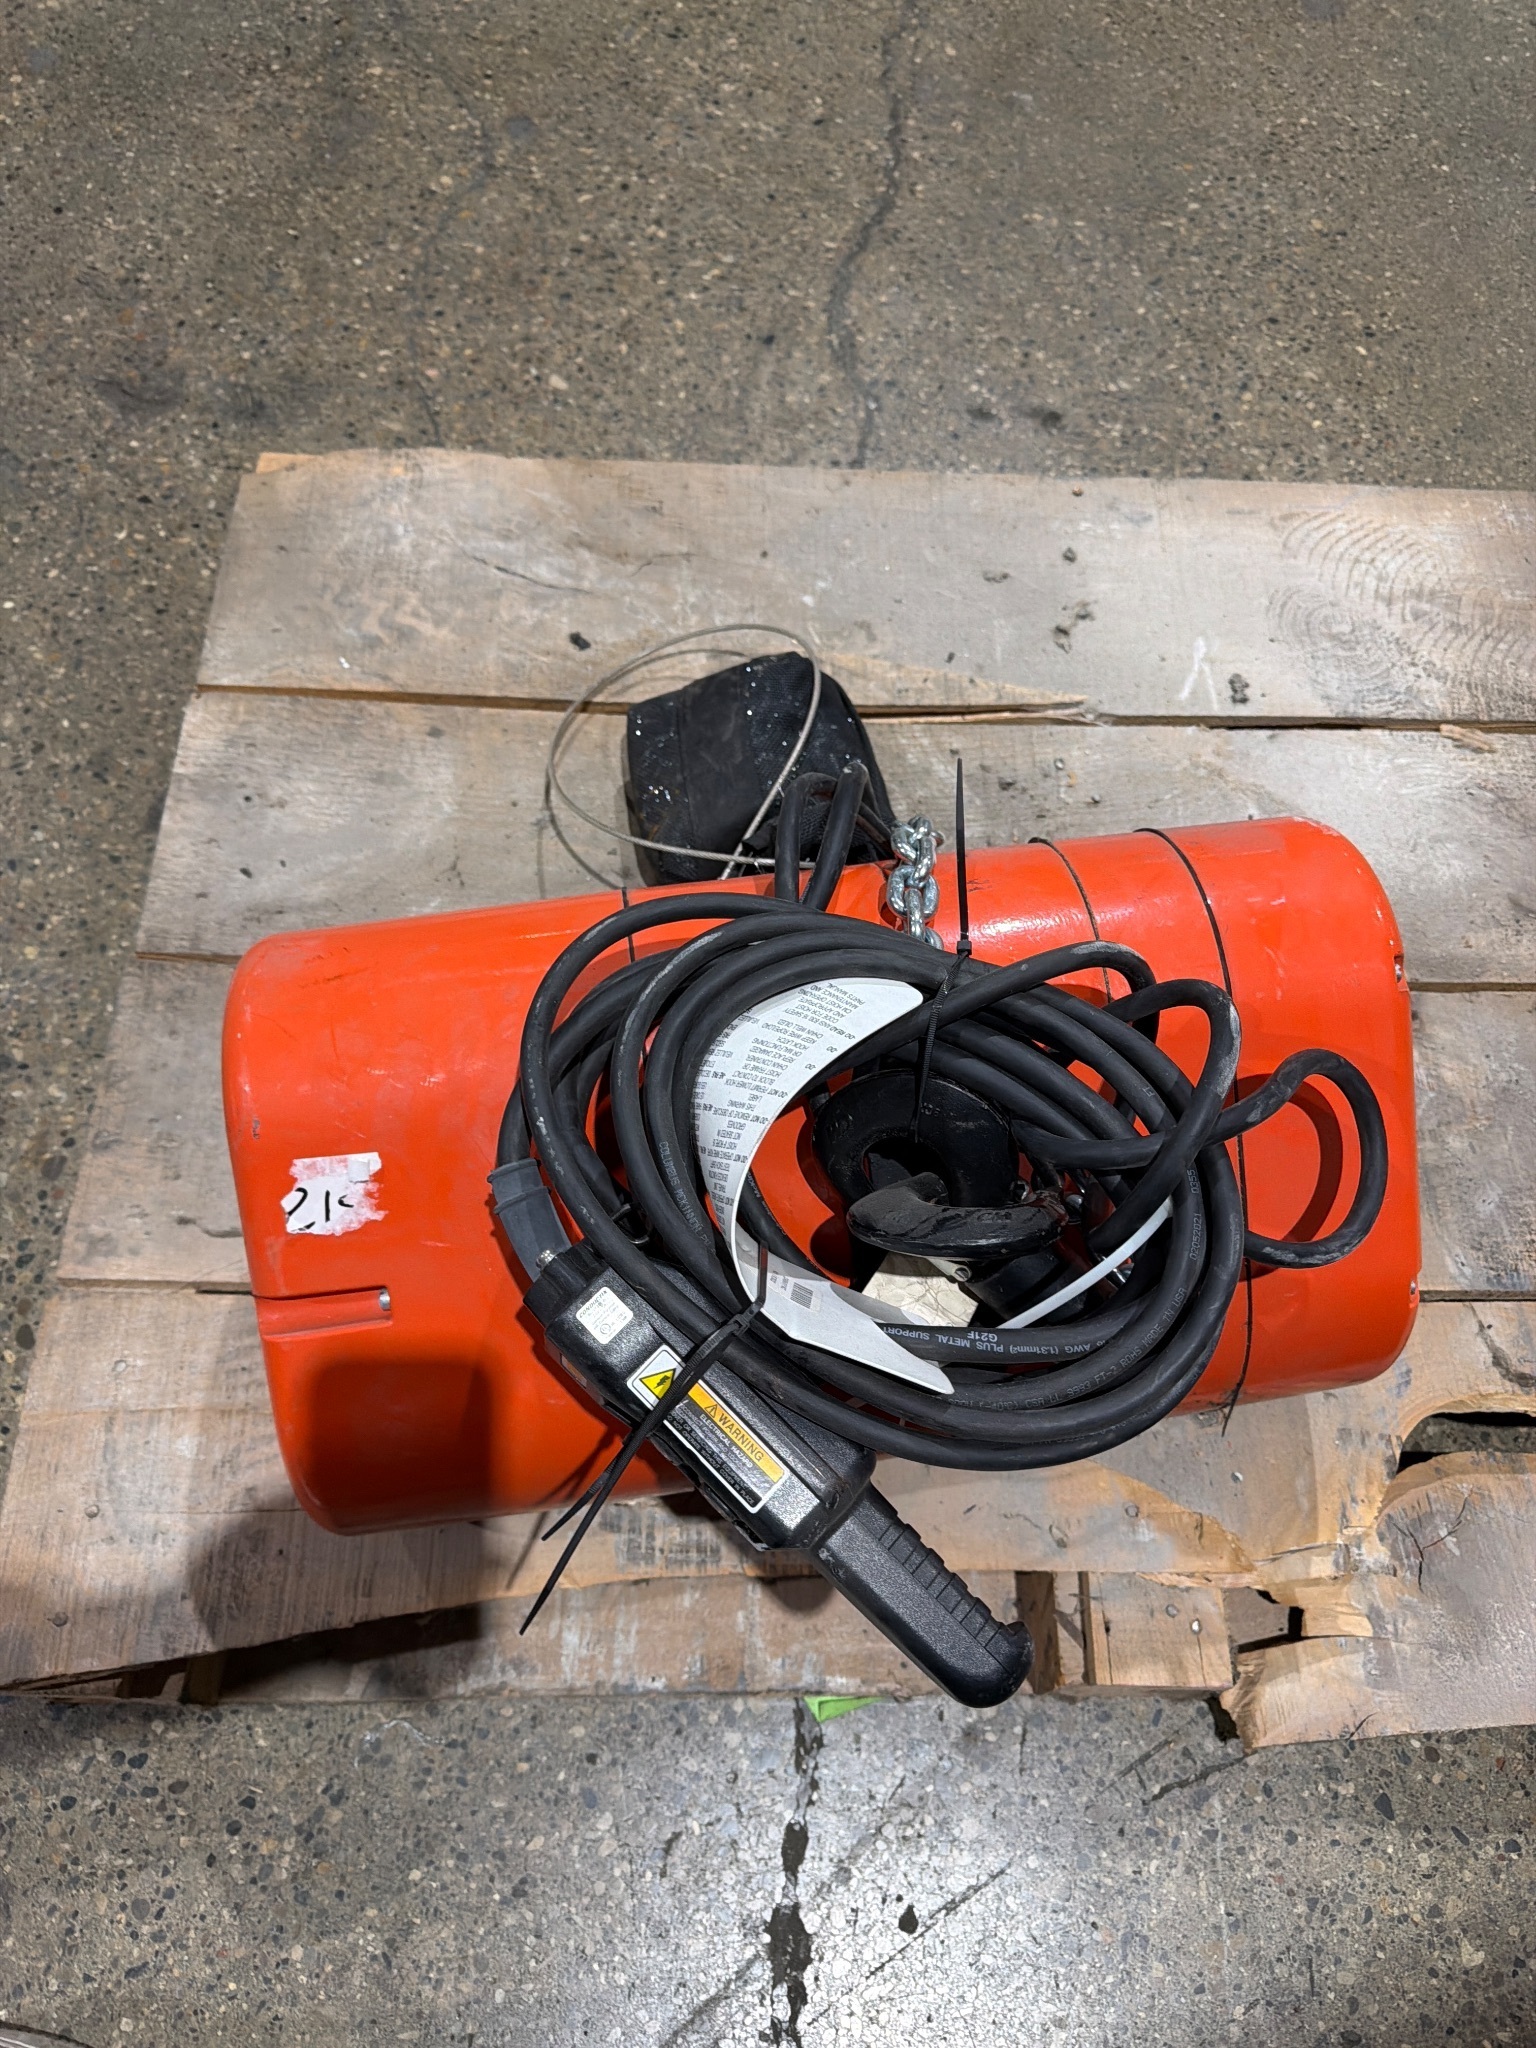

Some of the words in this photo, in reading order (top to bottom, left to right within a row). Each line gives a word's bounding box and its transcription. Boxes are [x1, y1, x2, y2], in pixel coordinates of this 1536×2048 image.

[809, 983, 822, 992] AND
[825, 982, 847, 996] MANUAL
[821, 989, 858, 1009] MAINTENANCE
[825, 999, 842, 1009] HOIST
[846, 993, 865, 1005] PARTS
[783, 1007, 803, 1017] SAFETY
[795, 1003, 812, 1012] HOIST
[841, 1006, 852, 1014] CM
[810, 1009, 823, 1017] FOR
[820, 1013, 839, 1023] CODE
[831, 1010, 845, 1019] AND
[792, 1023, 807, 1032] WELL
[829, 1025, 846, 1035] READ
[787, 1031, 802, 1039] WIRE
[805, 1029, 823, 1038] CHAIN
[800, 1036, 817, 1044] KEEP
[749, 1045, 773, 1056] DAMAGED
[791, 1041, 809, 1051] HOOK
[745, 1053, 772, 1066] CONTAINER
[771, 1051, 795, 1063] REPLACE
[749, 1064, 766, 1073] FRAME
[770, 1061, 788, 1070] CHAIN
[764, 1068, 781, 1078] HOIST
[757, 1075, 775, 1085] BLOCK
[750, 1084, 768, 1093] PERMIT
[658, 1139, 681, 1187] COLUMBUS
[745, 1170, 761, 1198] McKin
[1186, 1169, 1199, 1193] 0355
[287, 1183, 358, 1232] 21
[1189, 1212, 1201, 1260] 02052021
[1118, 1345, 1142, 1367] ROHS
[1140, 1322, 1163, 1346] MADE
[1161, 1308, 1174, 1322] IN
[1169, 1286, 1187, 1307] USA
[881, 1326, 929, 1340] SUPPORT
[966, 1330, 997, 1341] G21F
[935, 1333, 970, 1347] METAL
[975, 1341, 1003, 1352] PLUS
[1064, 1343, 1091, 1353] AWG
[699, 1413, 731, 1446] ELECTRICAL
[730, 1445, 753, 1468] HAZARD
[717, 1412, 765, 1462] WARNING
[682, 1423, 691, 1432] OR
[690, 1430, 712, 1454] SERVICING
[712, 1453, 723, 1464] THIS
[672, 1420, 682, 1430] NOT
[681, 1429, 701, 1449] OPERATE
[700, 1449, 720, 1469] WITHOUT
[719, 1468, 734, 1484] COVER
